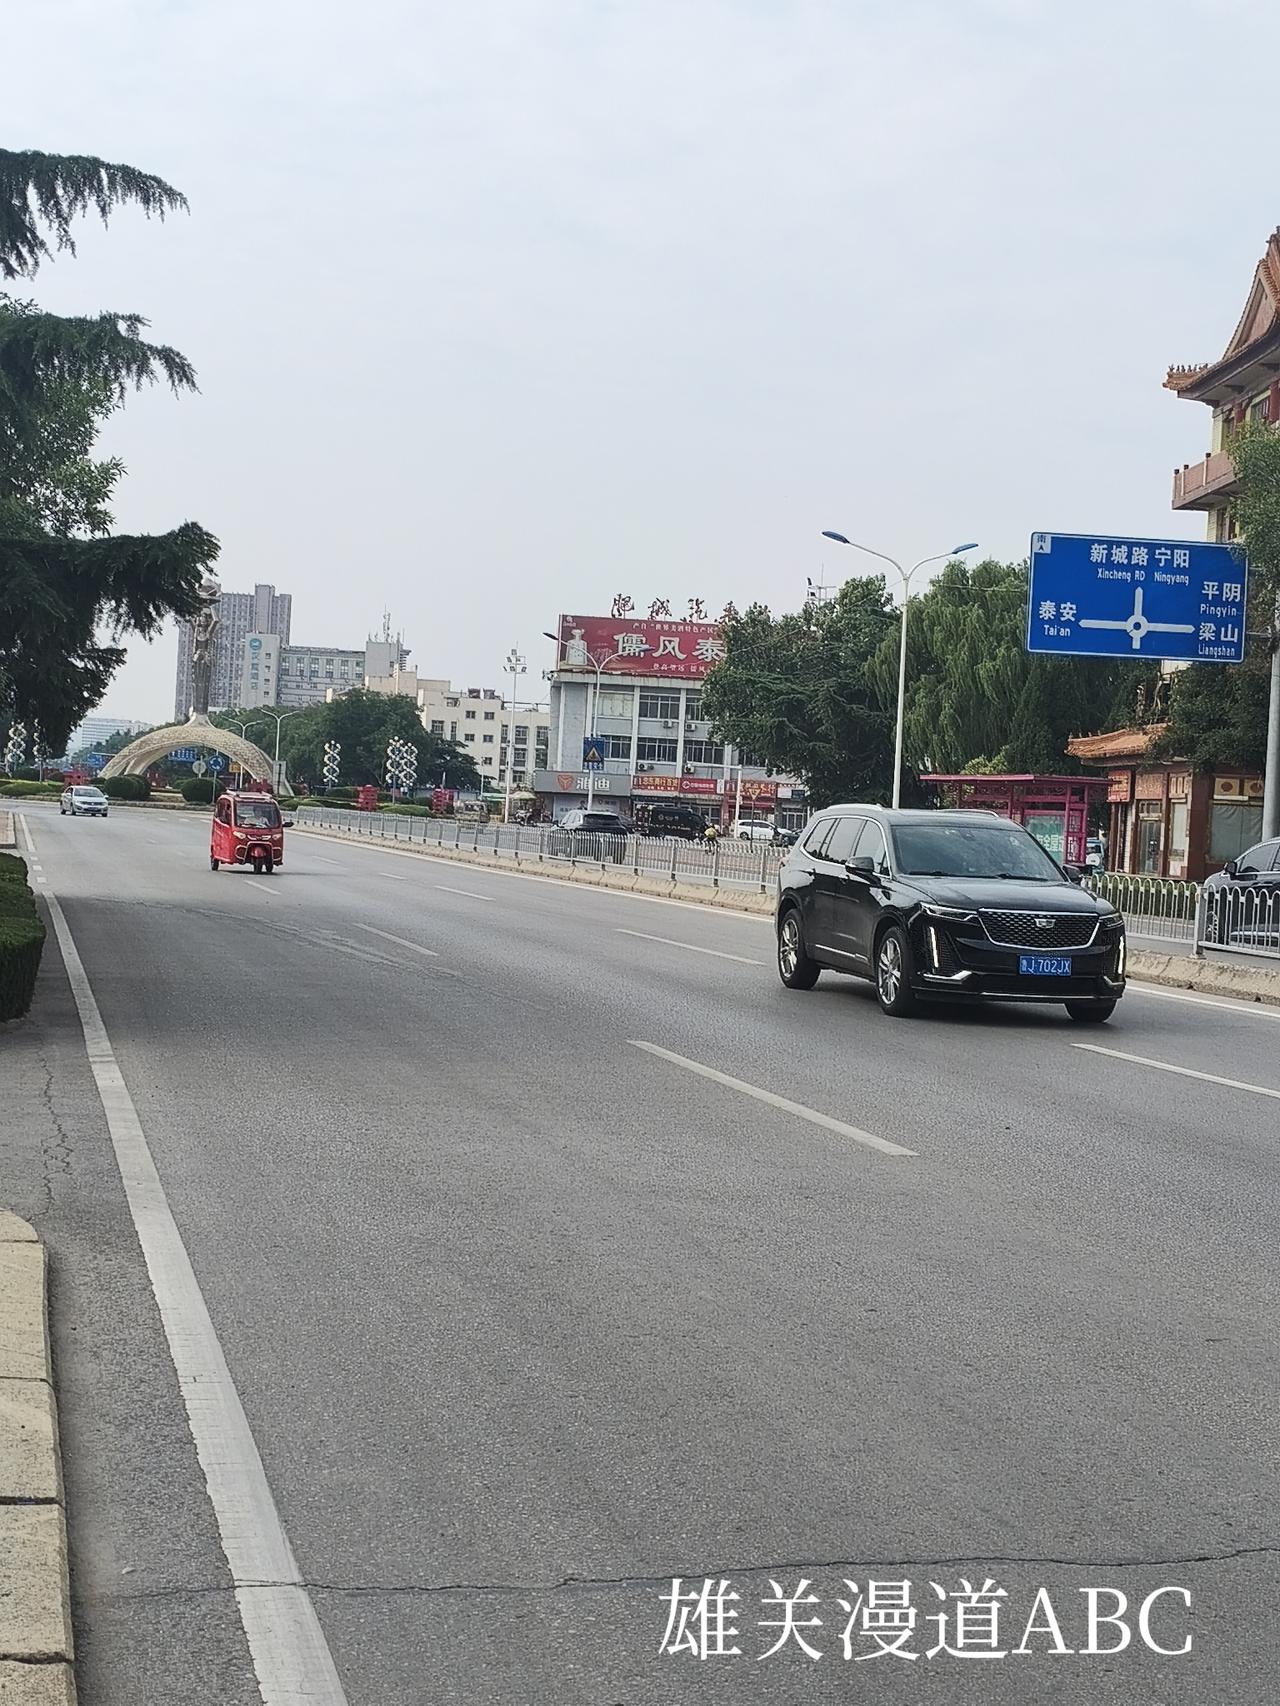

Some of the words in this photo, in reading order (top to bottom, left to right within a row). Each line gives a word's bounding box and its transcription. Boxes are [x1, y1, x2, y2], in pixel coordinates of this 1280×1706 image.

[1089, 543, 1149, 567] 新城路
[1154, 547, 1190, 568] 宁阳
[1097, 567, 1132, 583] Xincheng
[1134, 570, 1145, 581] RD
[1153, 571, 1190, 586] Ningyang
[1202, 581, 1242, 602] 平阴
[1038, 600, 1077, 622] 泰安
[1199, 603, 1237, 617] Pingyin
[1198, 622, 1239, 643] 梁山
[1197, 644, 1236, 659] Liangshan
